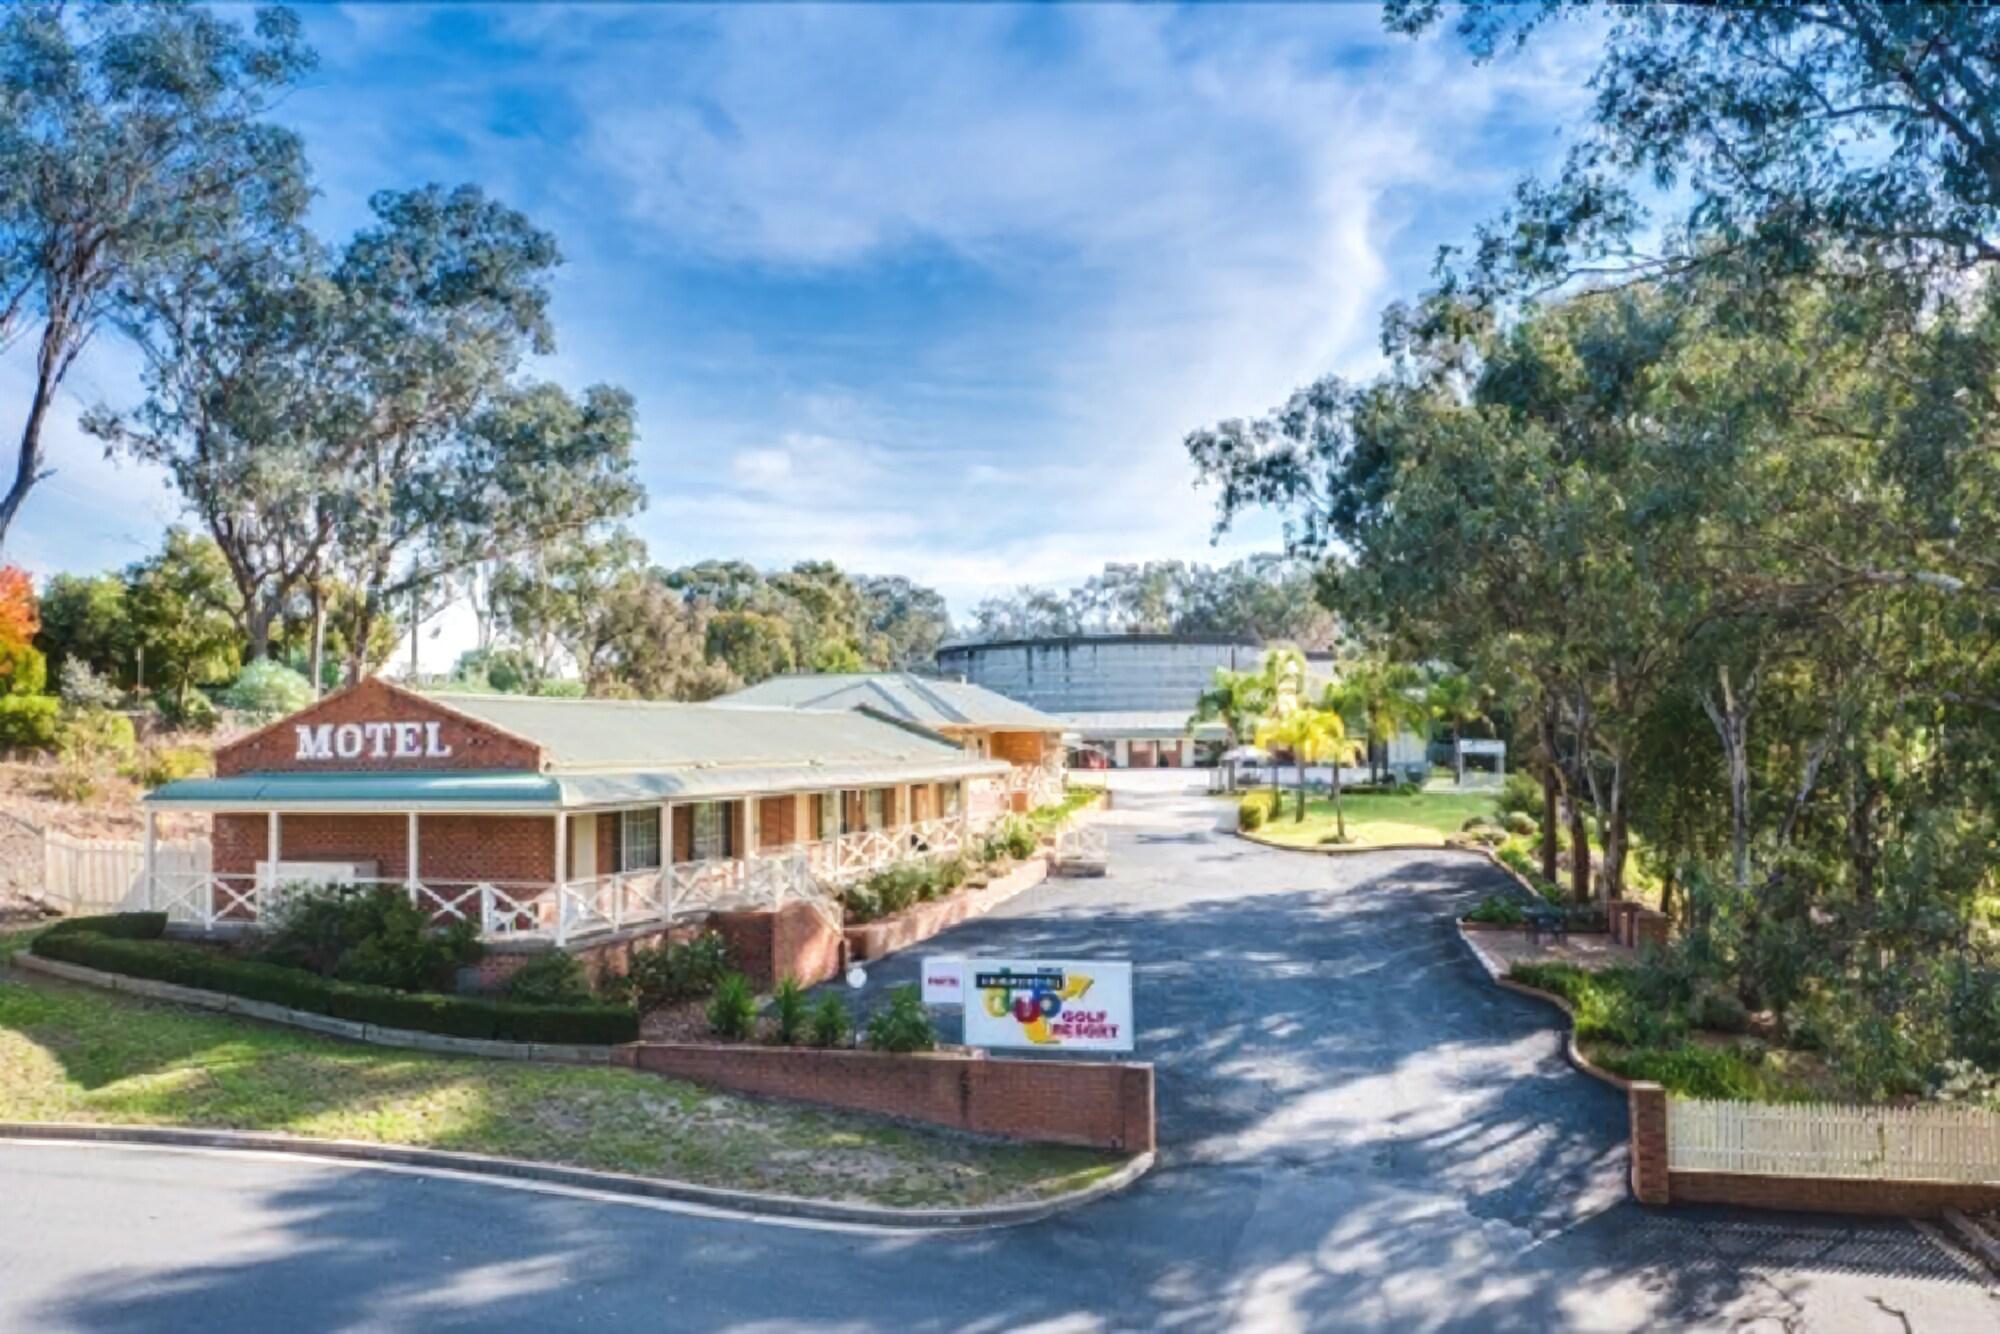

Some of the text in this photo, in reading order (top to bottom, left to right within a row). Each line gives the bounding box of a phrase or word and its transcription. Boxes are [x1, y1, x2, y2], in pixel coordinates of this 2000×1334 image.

[295, 722, 452, 760] MOTEL
[1062, 1010, 1107, 1022] GOLF
[1052, 1023, 1119, 1039] RESORT
